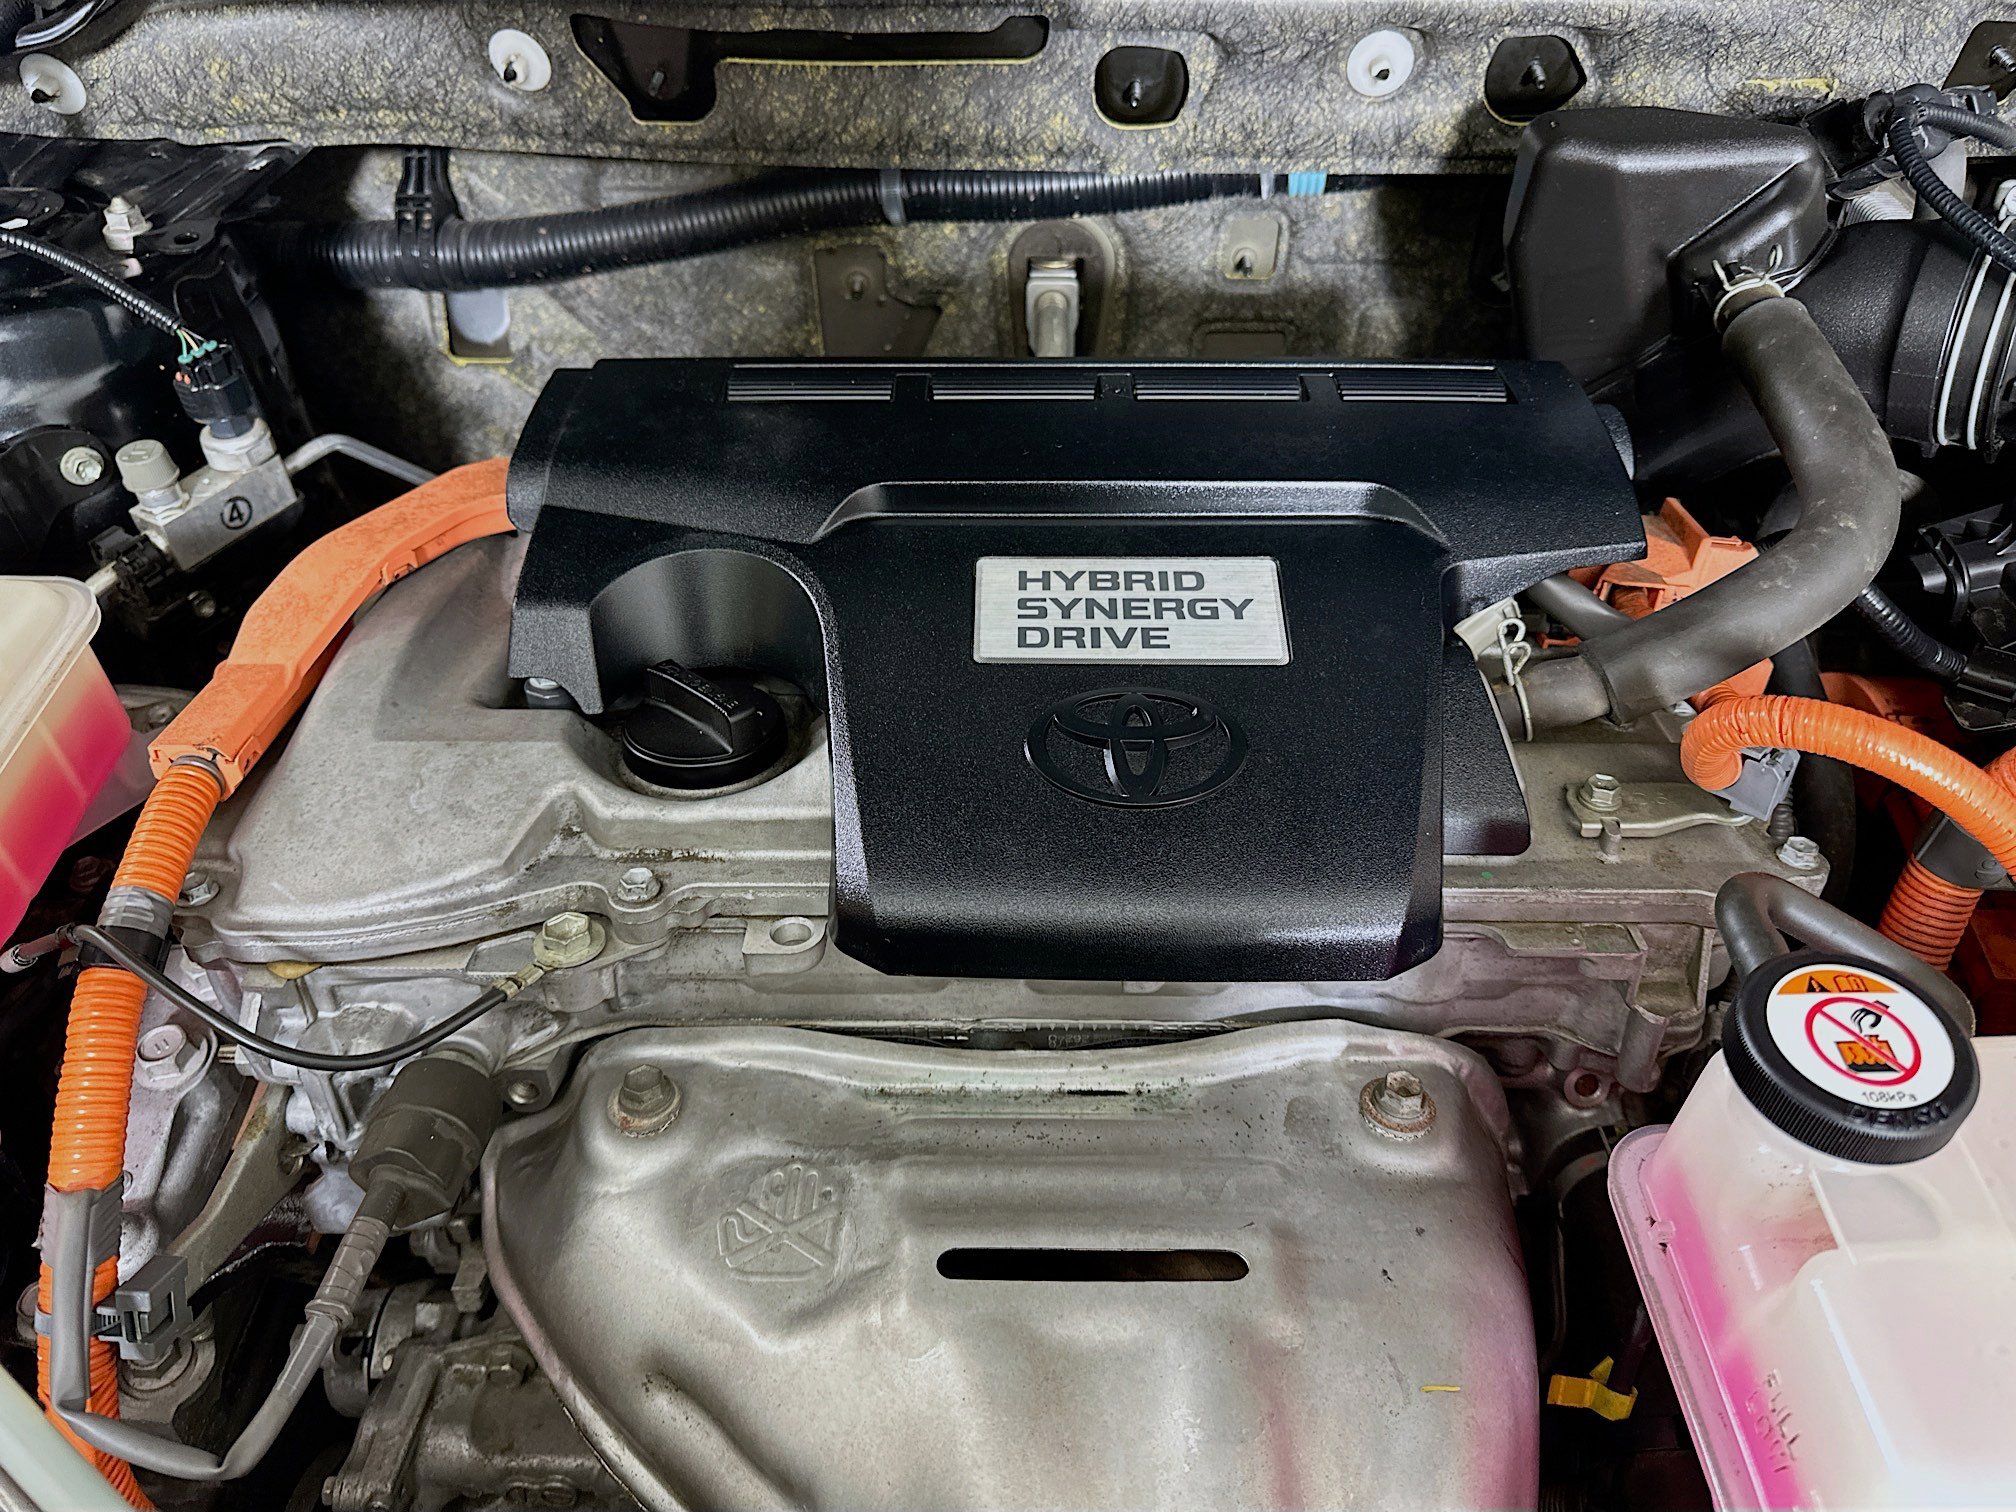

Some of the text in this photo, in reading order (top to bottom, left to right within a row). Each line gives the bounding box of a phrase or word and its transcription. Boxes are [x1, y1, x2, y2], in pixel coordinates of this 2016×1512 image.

[1018, 570, 1204, 592] HYBRID
[1017, 598, 1254, 620] SYNERGY
[1017, 626, 1171, 649] DRIVE
